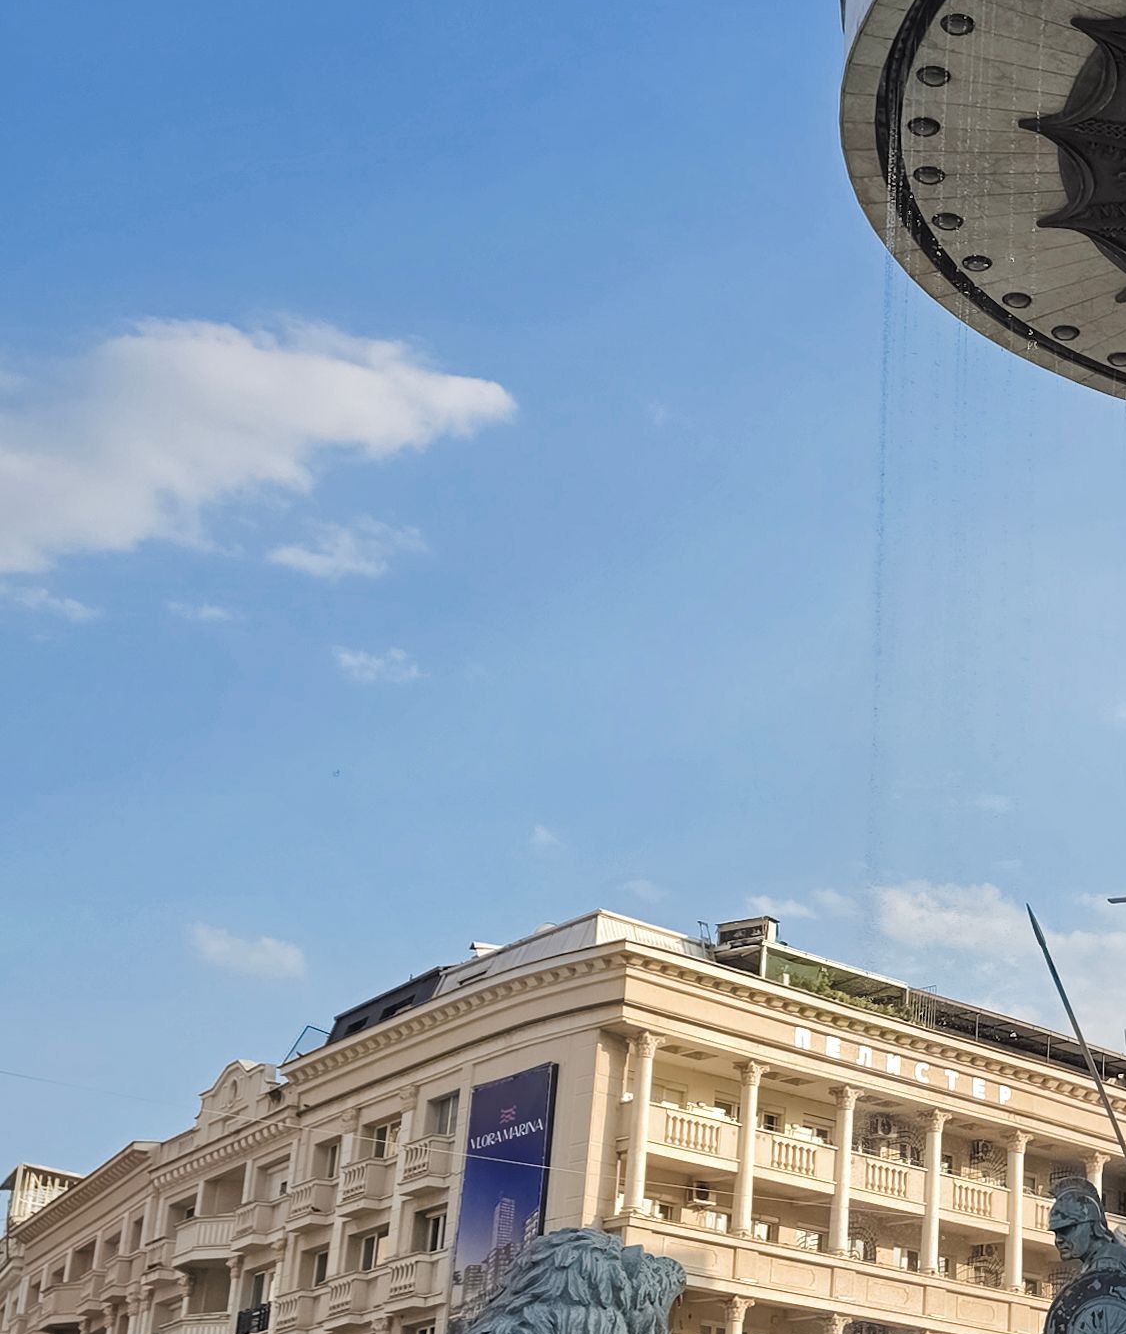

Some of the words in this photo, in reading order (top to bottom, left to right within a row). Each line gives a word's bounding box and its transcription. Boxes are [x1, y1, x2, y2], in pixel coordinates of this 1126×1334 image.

[794, 1026, 1012, 1106] ПЕЛИСТЕР
[470, 1130, 502, 1149] VLORA
[503, 1118, 544, 1142] MARINA
